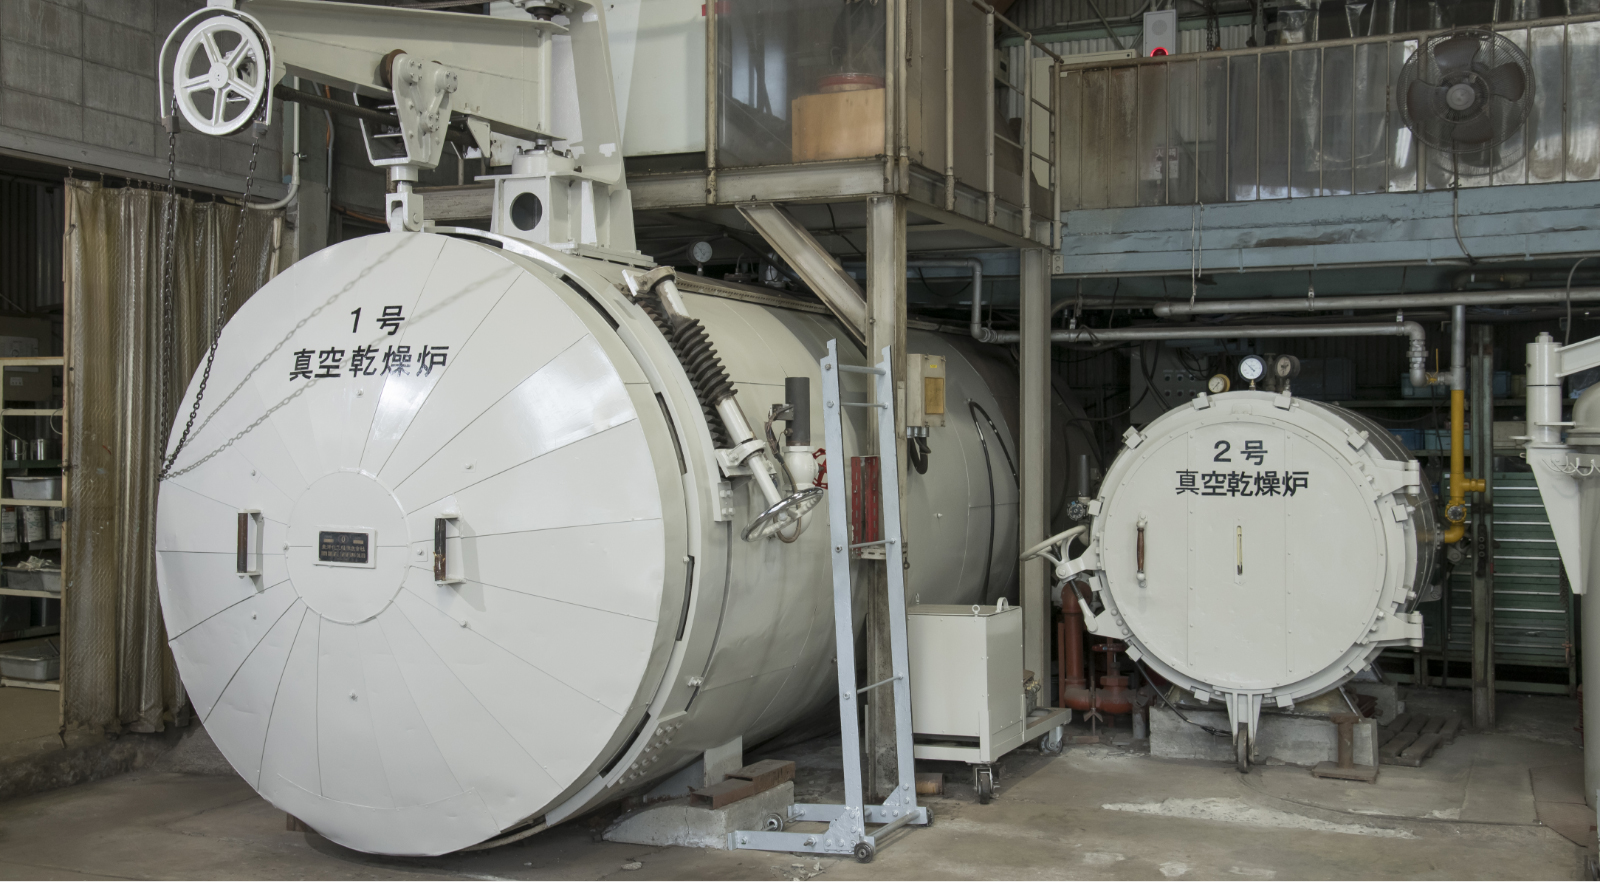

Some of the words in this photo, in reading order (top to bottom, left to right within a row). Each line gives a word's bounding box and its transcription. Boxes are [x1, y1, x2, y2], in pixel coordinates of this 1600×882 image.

[350, 305, 405, 336] 1号
[289, 344, 450, 382] 真空乾燥炉
[1213, 440, 1268, 466] 2号
[1175, 469, 1310, 498] 真空乾燥炉
